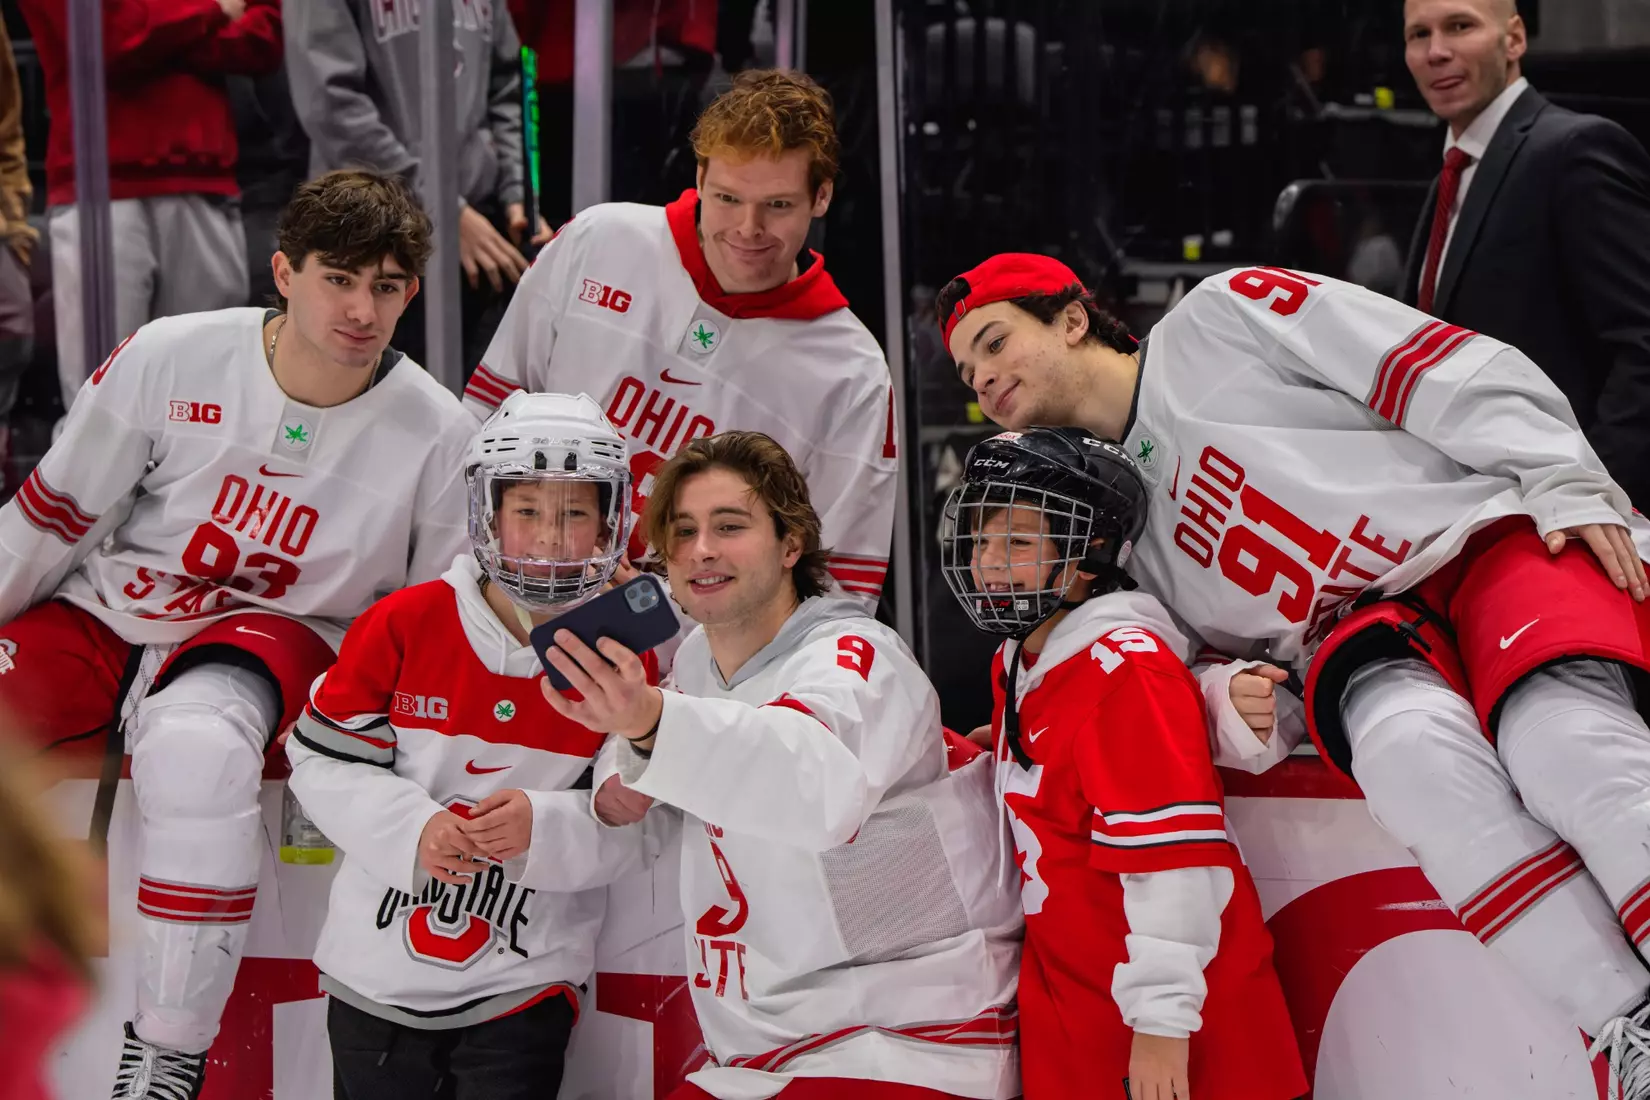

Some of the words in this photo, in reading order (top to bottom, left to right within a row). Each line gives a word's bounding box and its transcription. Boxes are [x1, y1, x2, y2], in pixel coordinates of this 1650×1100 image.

[1229, 265, 1324, 316] 91
[973, 458, 1010, 469] CCM
[1081, 436, 1136, 467] CCM
[211, 473, 320, 558] OHIO
[1173, 445, 1247, 569] OHIO
[1217, 483, 1342, 624] 91
[836, 634, 876, 683] 9
[1090, 627, 1159, 675] 15
